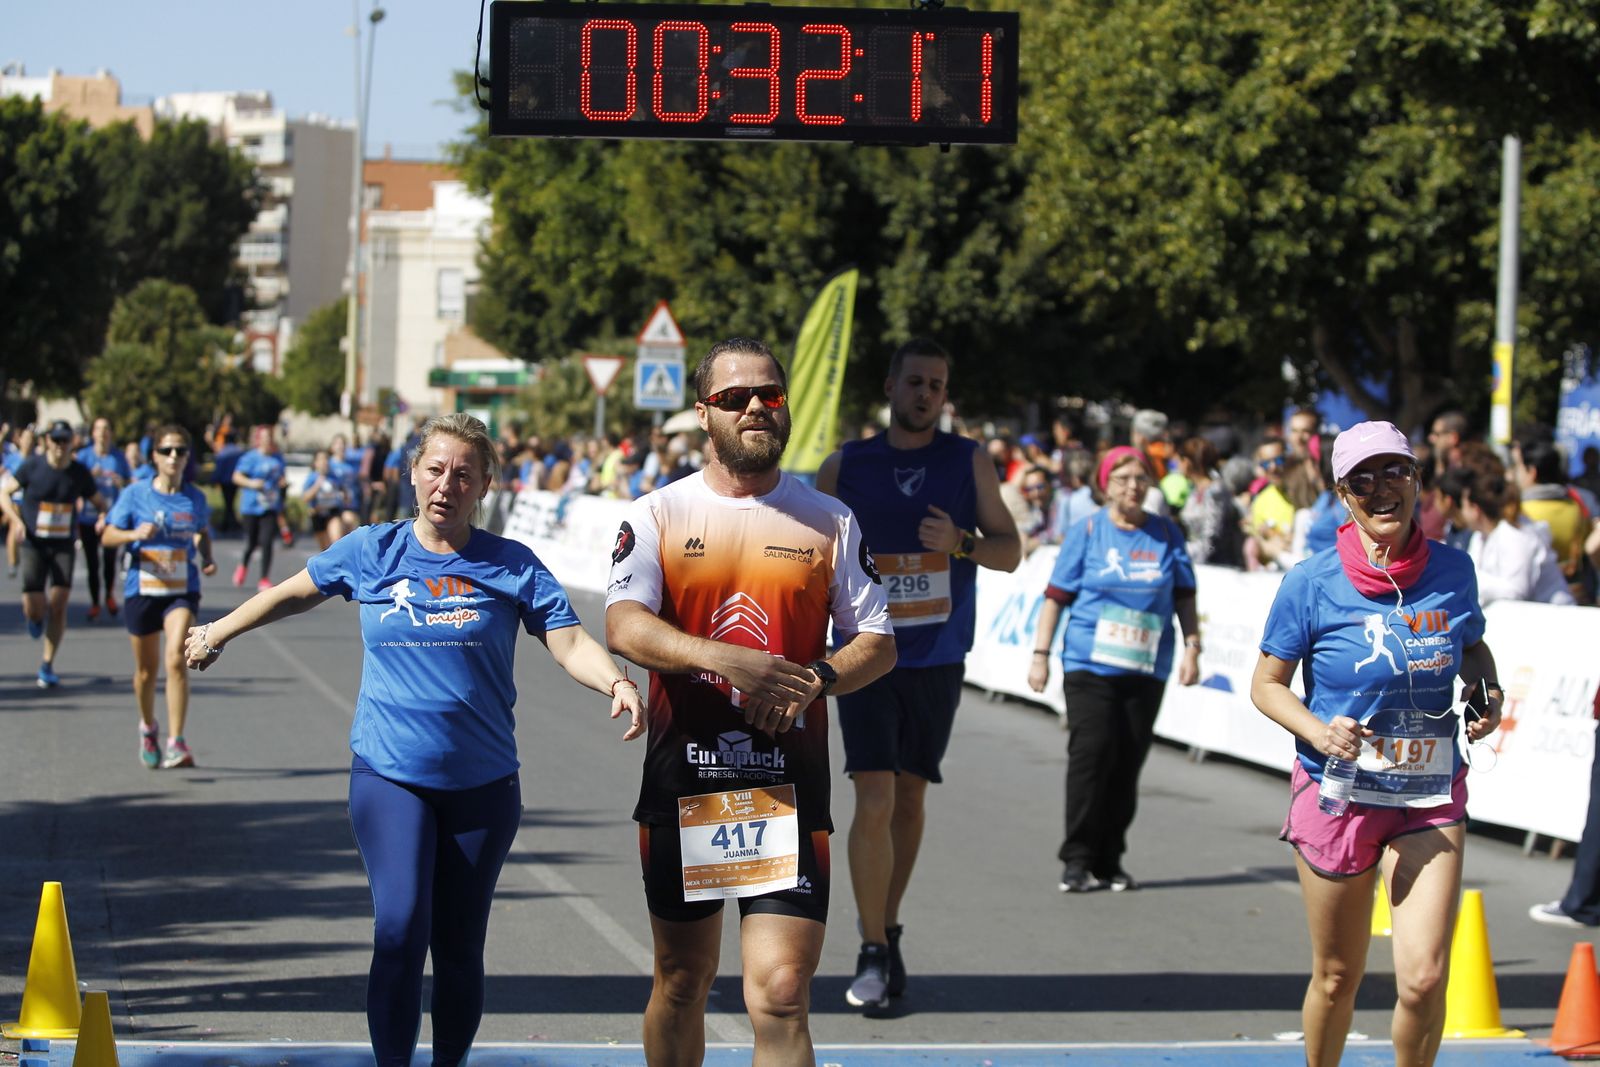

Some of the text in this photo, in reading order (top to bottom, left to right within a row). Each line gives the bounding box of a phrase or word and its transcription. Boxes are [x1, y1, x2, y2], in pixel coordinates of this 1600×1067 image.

[580, 19, 993, 125] 00:32:11
[763, 550, 813, 565] SALINAS CAR
[425, 576, 474, 597] VIII
[888, 574, 930, 594] 296
[1402, 609, 1450, 632] VIII
[1405, 636, 1453, 648] CARRERA
[686, 743, 785, 770] Europack
[1371, 737, 1437, 764] 1197
[733, 792, 753, 801] VIII
[711, 820, 768, 850] 417
[723, 848, 760, 859] JUANMA
